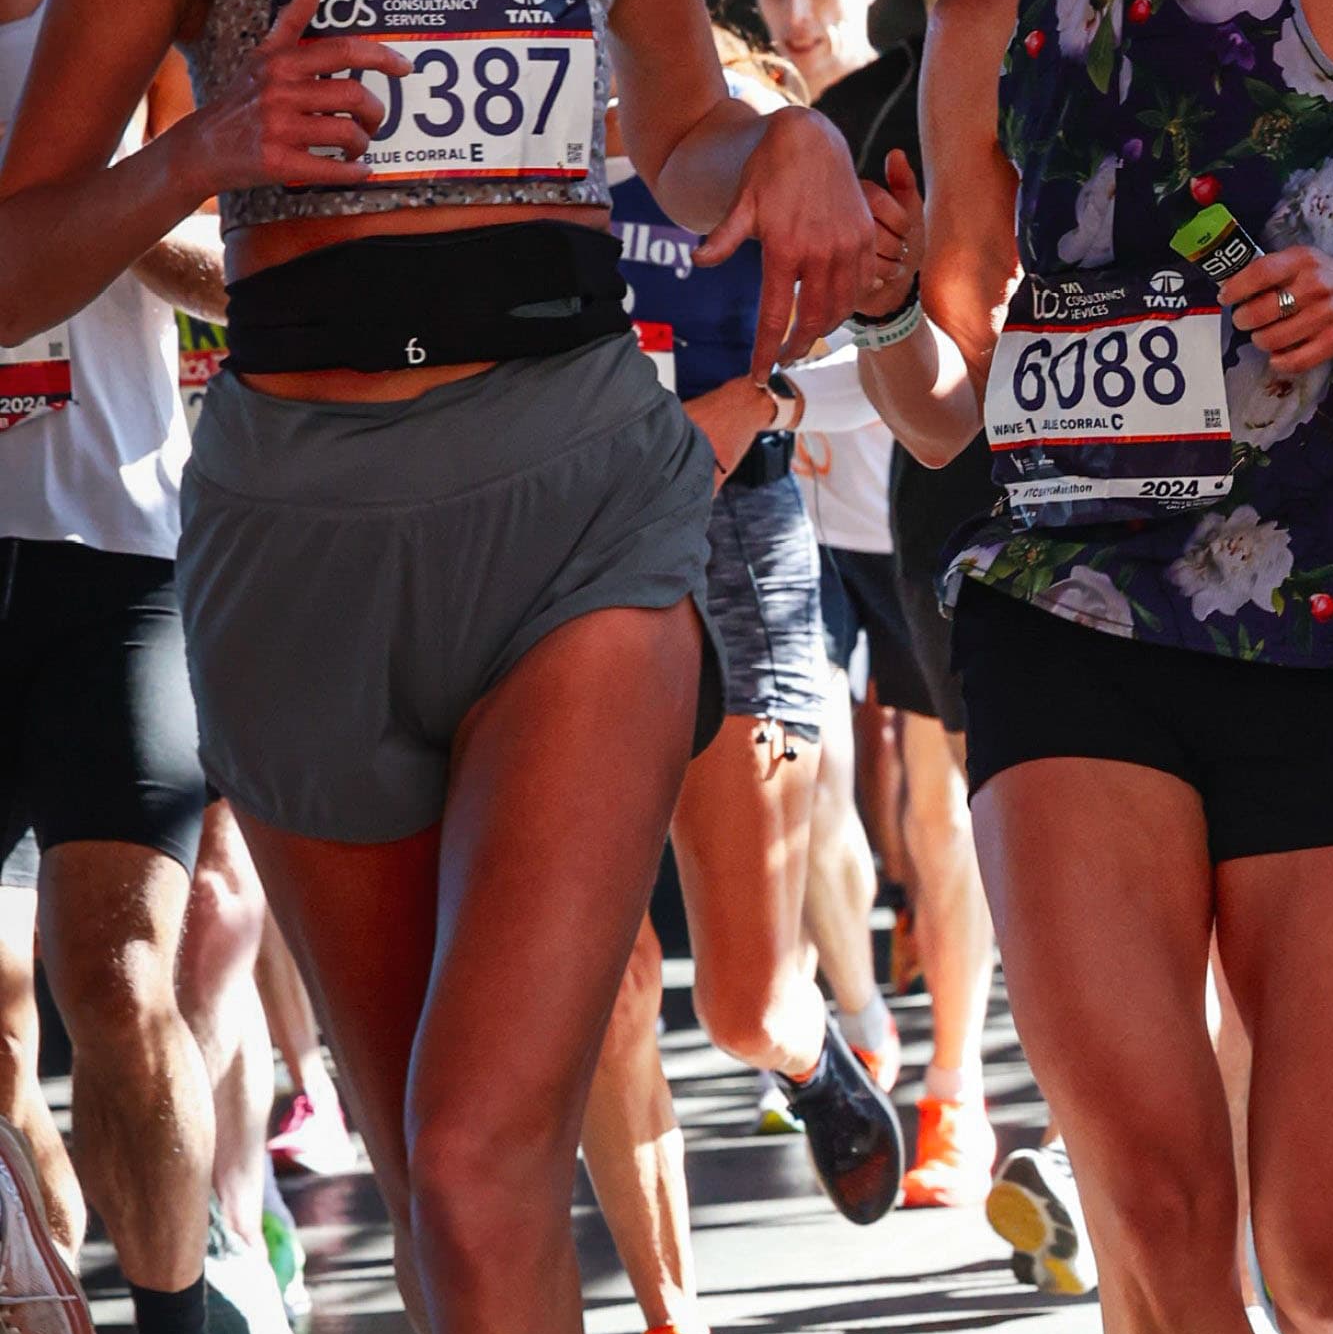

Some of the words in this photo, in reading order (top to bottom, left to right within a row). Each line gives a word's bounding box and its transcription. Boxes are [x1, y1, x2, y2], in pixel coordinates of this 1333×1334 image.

[385, 13, 446, 27] SERVICES
[505, 9, 555, 24] TATA
[364, 149, 402, 165] BLUE
[404, 149, 467, 163] CORRAL
[470, 143, 484, 162] E
[1143, 295, 1188, 308] TATA
[1013, 325, 1186, 412] 6088
[993, 422, 1024, 436] WAVE
[1025, 417, 1037, 434] 1
[1060, 417, 1109, 430] CORRAL
[1111, 413, 1124, 431] C
[1138, 480, 1199, 497] 2024
